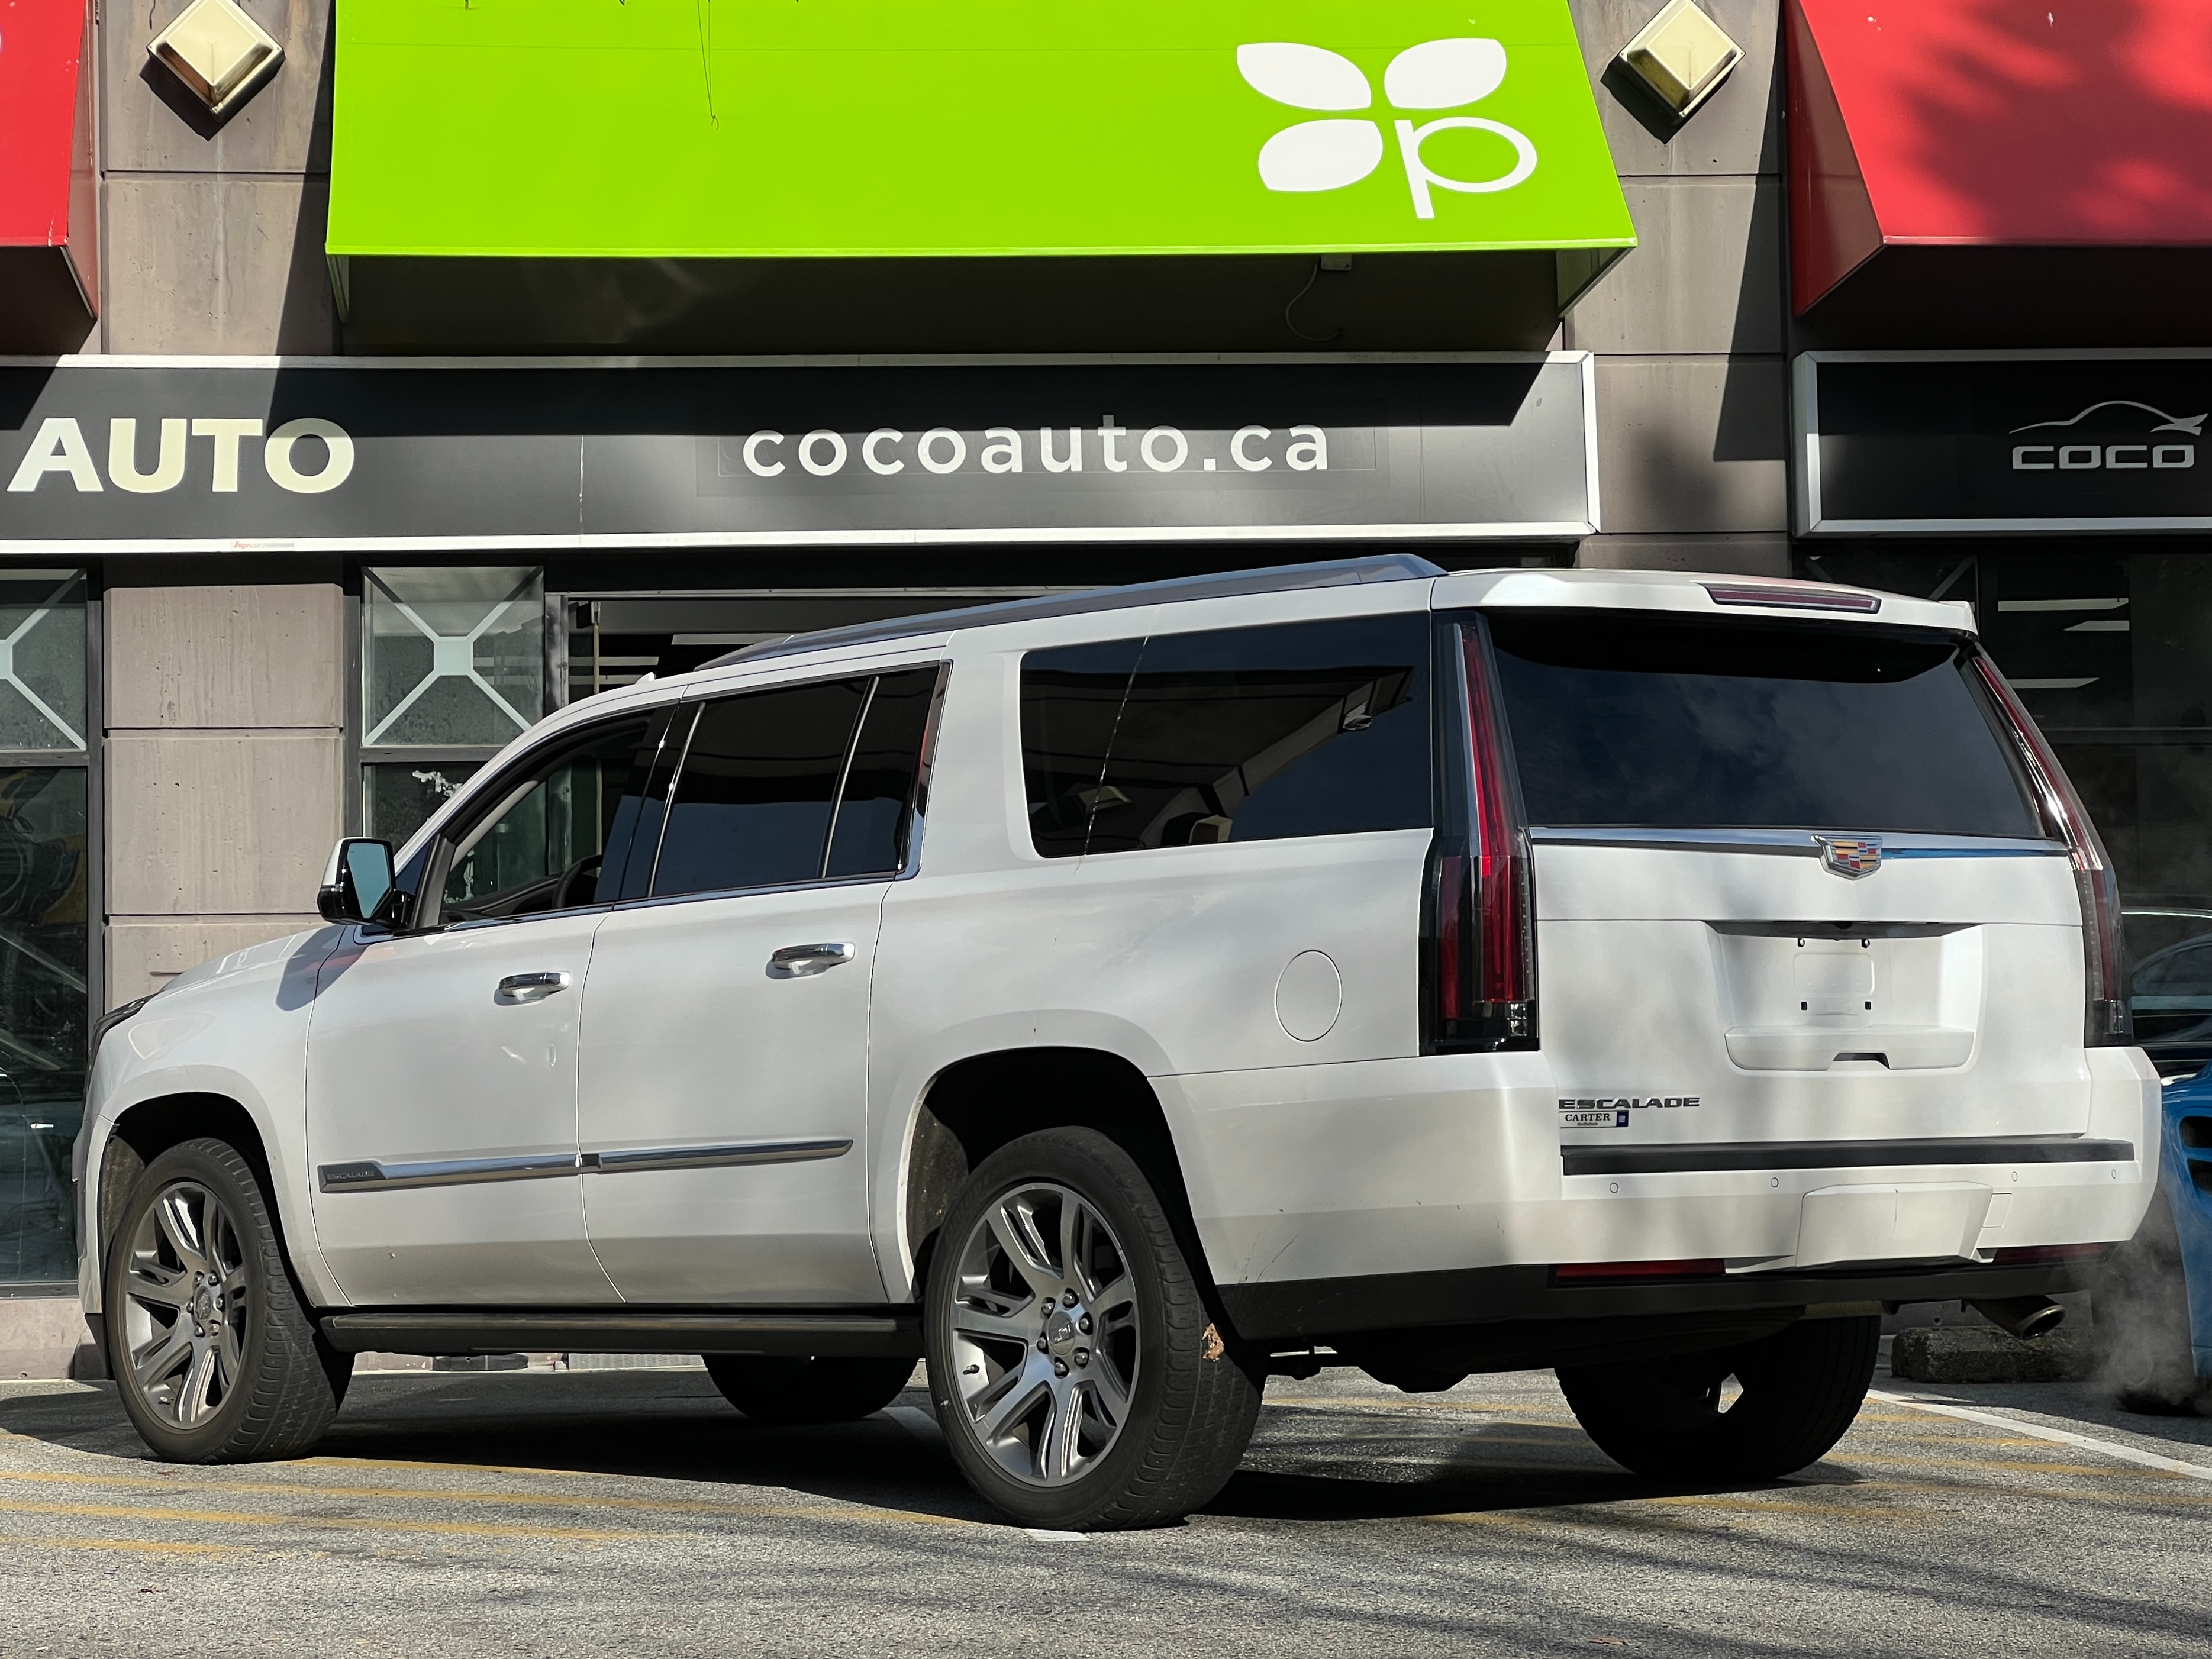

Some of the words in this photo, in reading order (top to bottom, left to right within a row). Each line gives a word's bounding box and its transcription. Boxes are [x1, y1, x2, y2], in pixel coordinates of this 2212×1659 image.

[7, 418, 354, 493] AUTO
[743, 415, 1329, 476] cocoauto.ca
[2013, 445, 2195, 469] COCO
[1559, 1096, 1700, 1109] ESCALADE
[1565, 1113, 1610, 1122] CARTER
